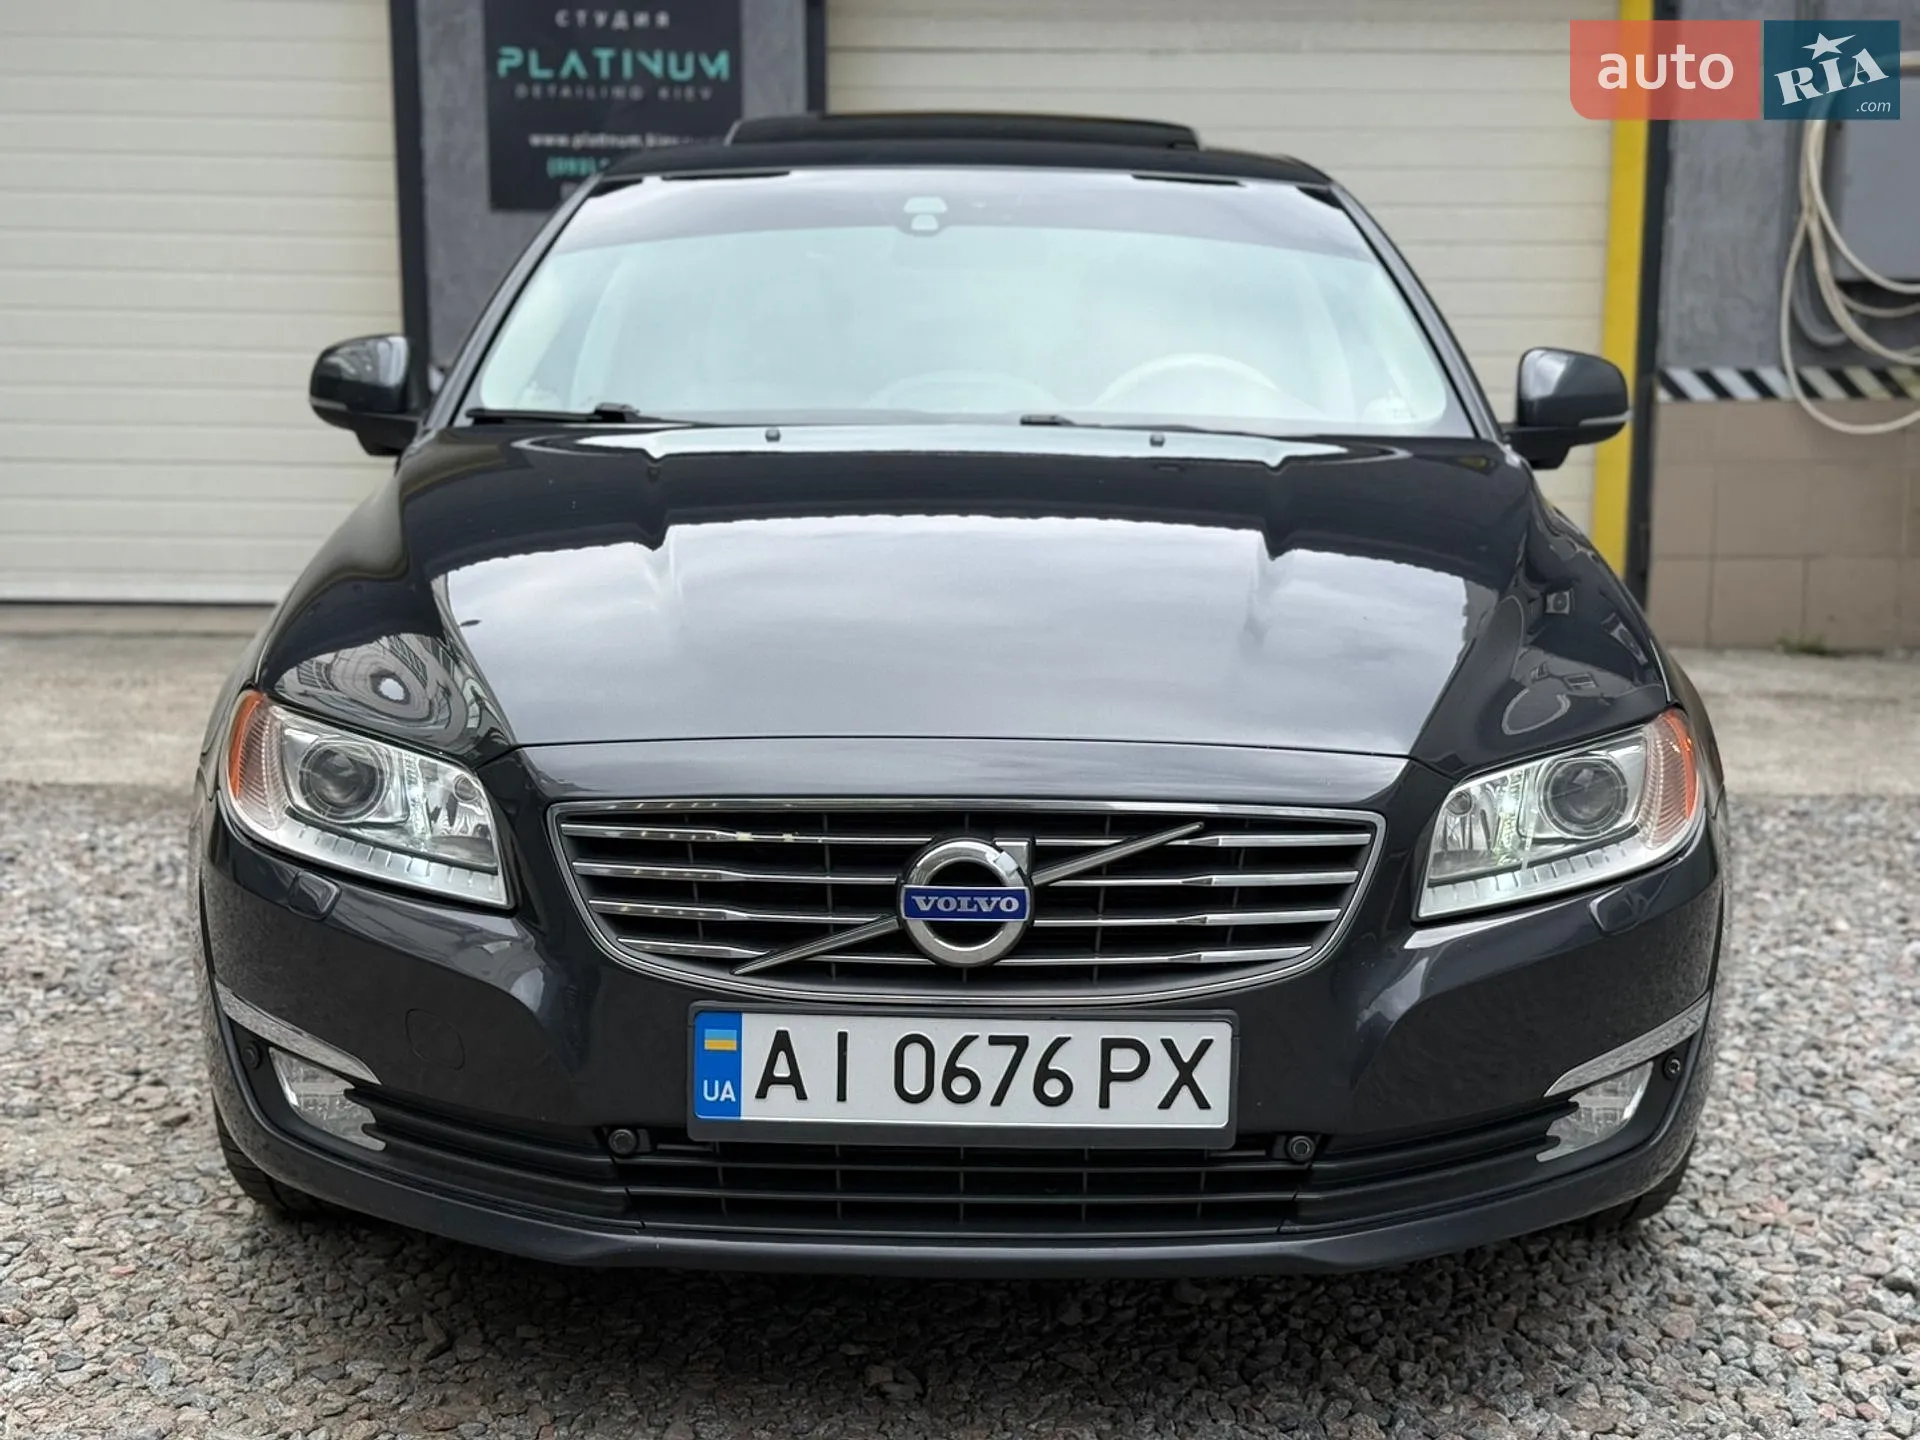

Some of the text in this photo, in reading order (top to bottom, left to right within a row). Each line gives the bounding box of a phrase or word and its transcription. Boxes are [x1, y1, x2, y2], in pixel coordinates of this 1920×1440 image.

[555, 9, 670, 30] СТУДИЯ
[497, 46, 730, 81] PLATINUM
[514, 85, 714, 101] DETAILING KIEV
[911, 896, 1020, 912] VOLVO
[755, 1029, 1215, 1111] AI 0676 PX
[703, 1079, 737, 1102] UA
